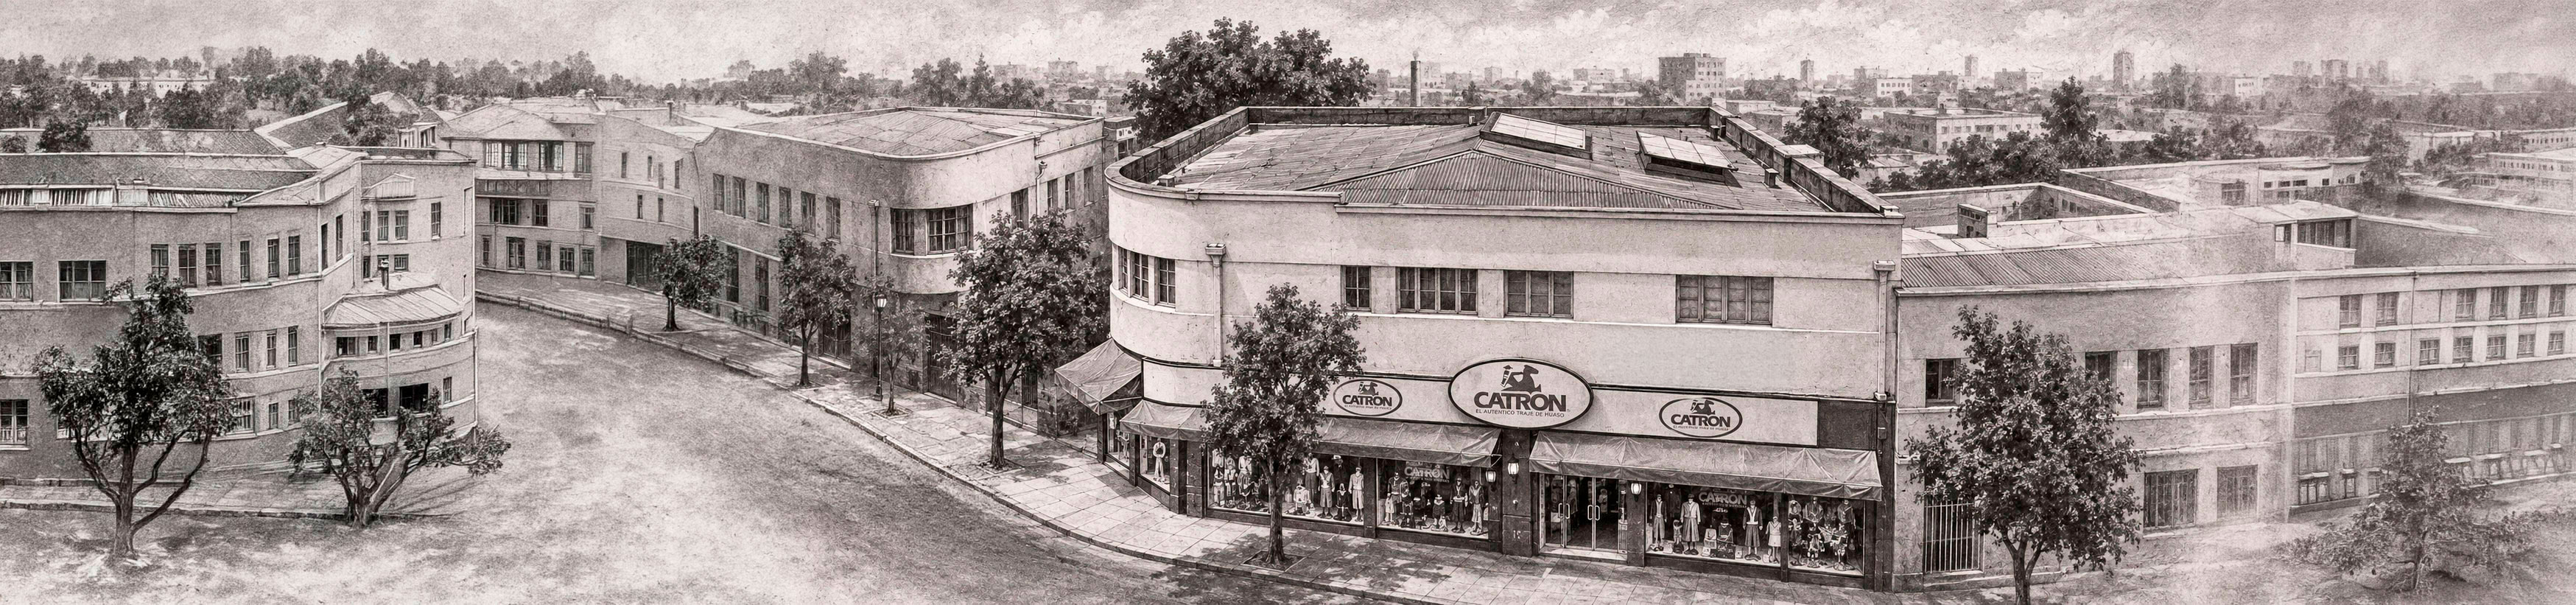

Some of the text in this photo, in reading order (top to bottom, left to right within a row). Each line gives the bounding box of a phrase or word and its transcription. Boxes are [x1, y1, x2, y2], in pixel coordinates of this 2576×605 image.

[1342, 395, 1392, 406] CATRON
[1474, 391, 1566, 412] CATRON
[1671, 414, 1730, 427] CATRON
[1404, 466, 1450, 480] CATRON
[1699, 492, 1747, 506] CATRON
